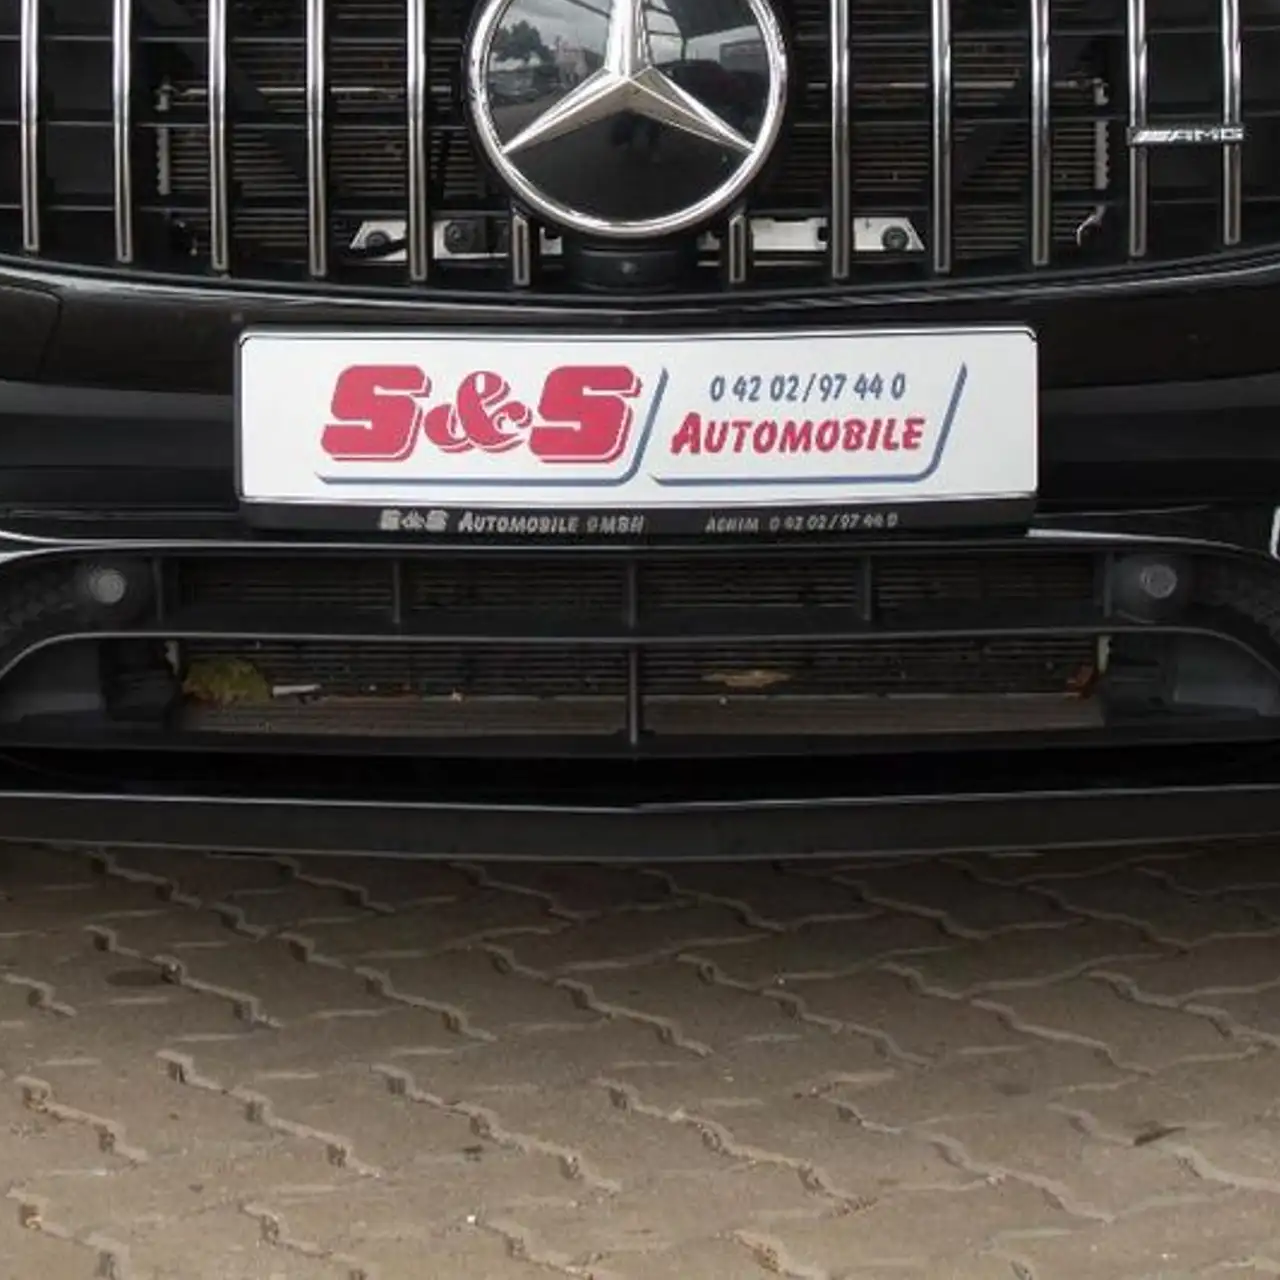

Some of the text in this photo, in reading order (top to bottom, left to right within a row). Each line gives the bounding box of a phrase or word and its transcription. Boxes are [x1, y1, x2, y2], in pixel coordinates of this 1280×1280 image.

[1168, 127, 1244, 142] AMG
[709, 373, 906, 402] 0 42 02/97 44 0
[320, 365, 643, 463] S&S
[670, 411, 925, 454] AUTOMOBILE
